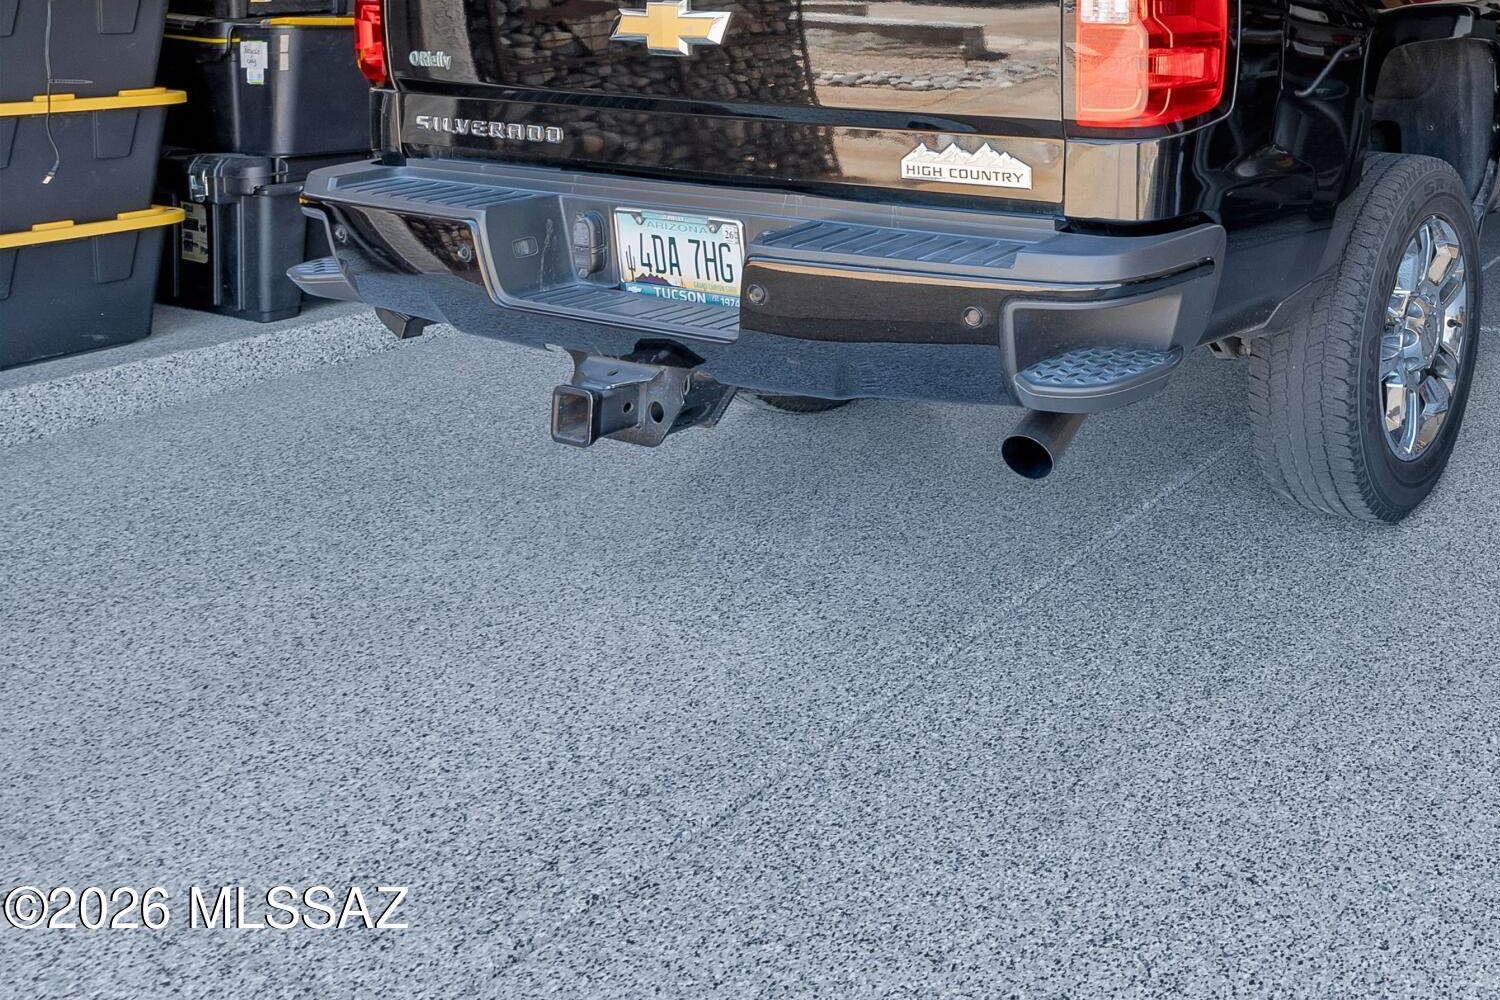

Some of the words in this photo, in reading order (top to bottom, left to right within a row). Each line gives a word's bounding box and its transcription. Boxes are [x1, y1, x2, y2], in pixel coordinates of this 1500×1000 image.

[416, 115, 564, 144] SILVERADO
[906, 164, 943, 177] HIGH
[949, 168, 1024, 183] COUNTRY
[646, 220, 708, 234] ARIZONA
[687, 238, 734, 283] 7HG
[653, 286, 707, 304] TUCSON
